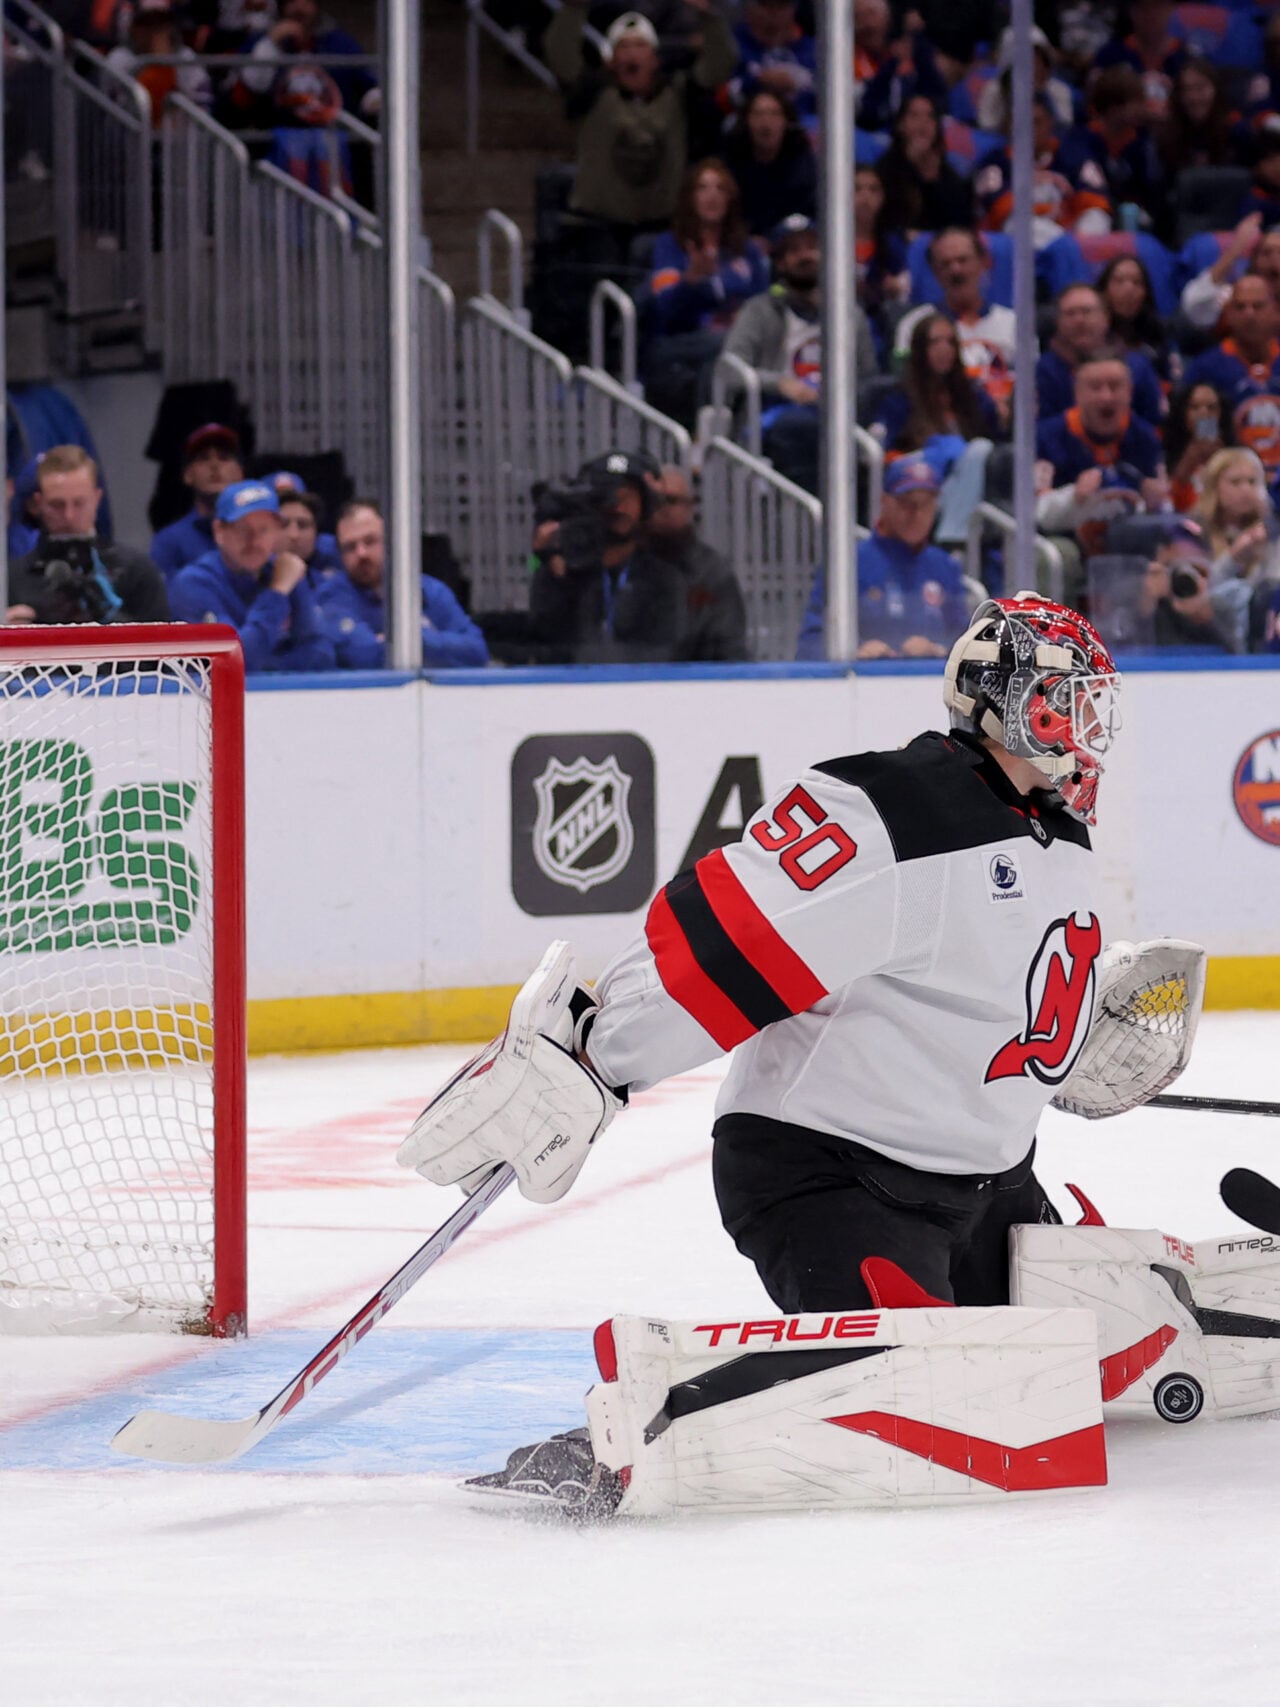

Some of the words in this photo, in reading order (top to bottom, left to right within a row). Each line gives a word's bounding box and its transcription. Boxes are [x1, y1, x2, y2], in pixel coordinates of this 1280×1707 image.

[556, 790, 614, 861] NHL
[750, 783, 858, 891] 50
[992, 890, 1023, 901] Prudential
[1163, 1234, 1196, 1266] TRUE
[1218, 1236, 1274, 1254] NITRO
[692, 1314, 881, 1347] TRUE
